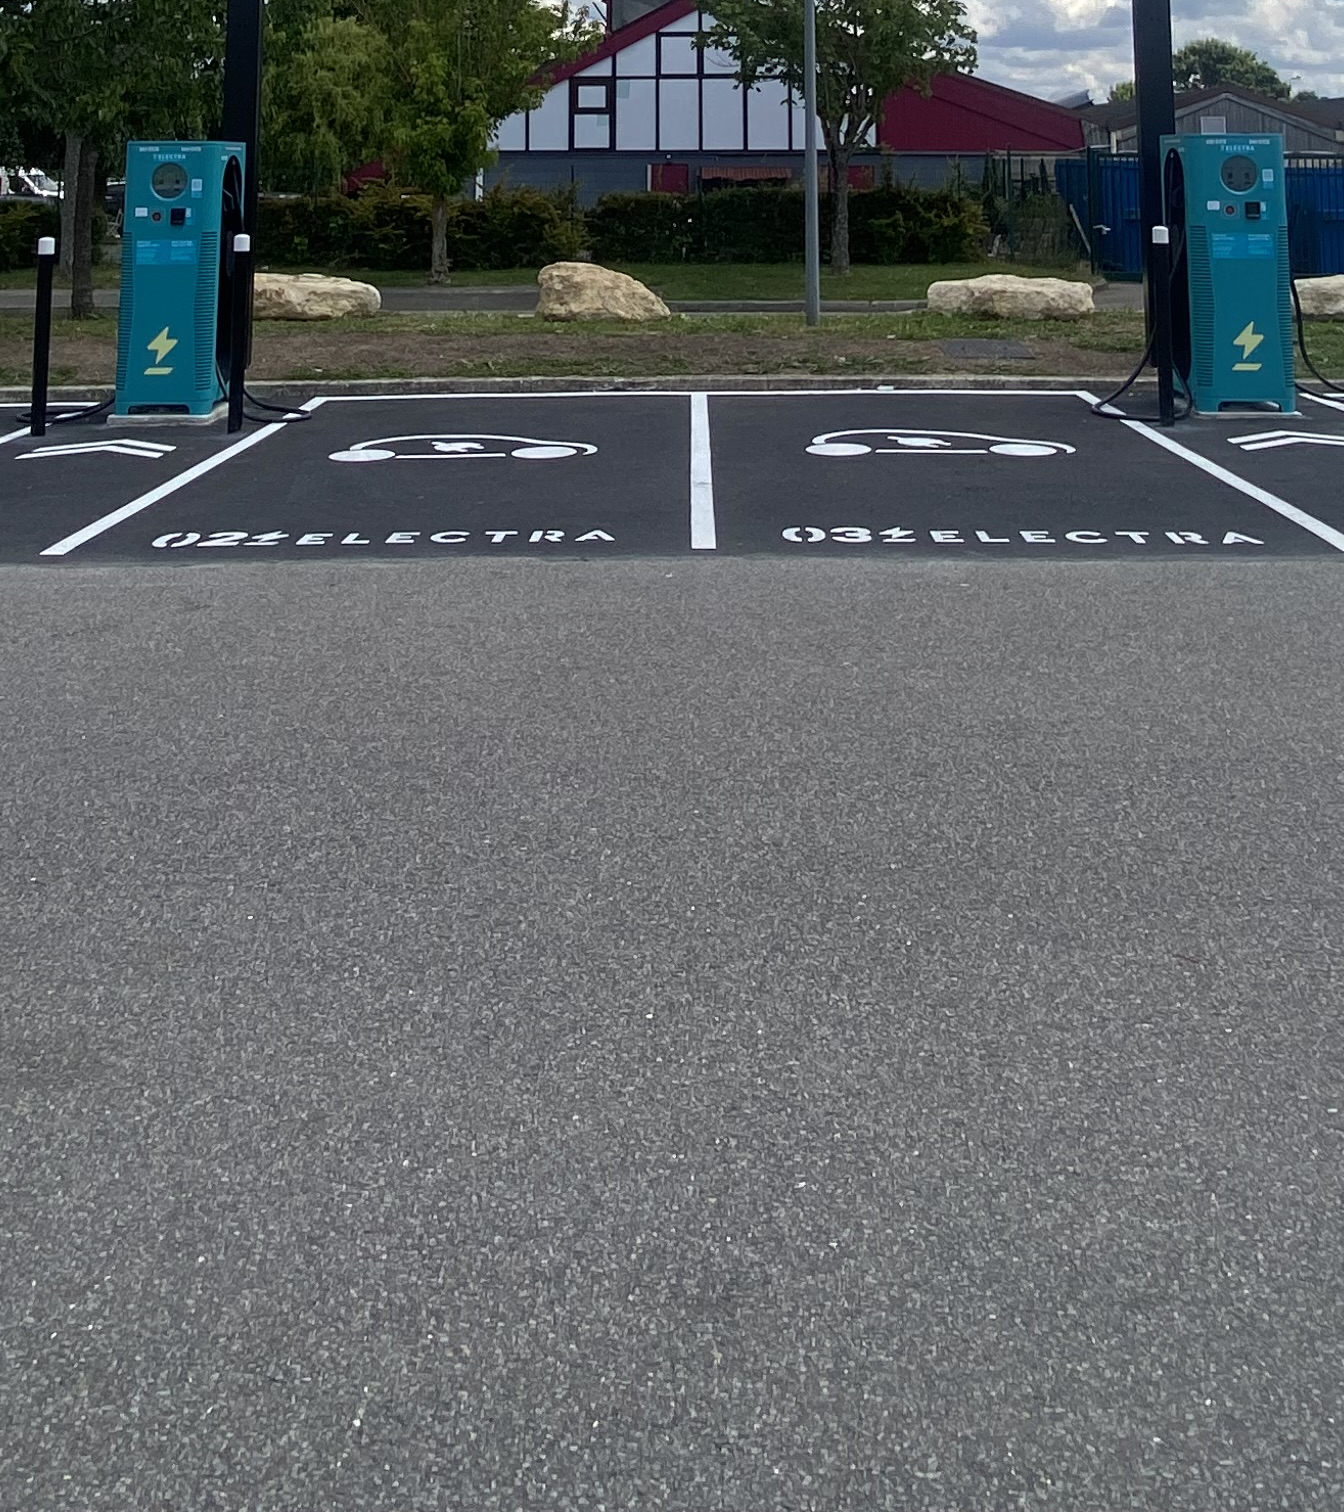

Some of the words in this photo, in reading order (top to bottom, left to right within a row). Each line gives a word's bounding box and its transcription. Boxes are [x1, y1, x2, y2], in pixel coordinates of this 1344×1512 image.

[151, 532, 249, 549] 02
[295, 530, 616, 546] ELECTRA
[781, 526, 873, 544] 03
[929, 529, 1265, 545] ELECTRA
